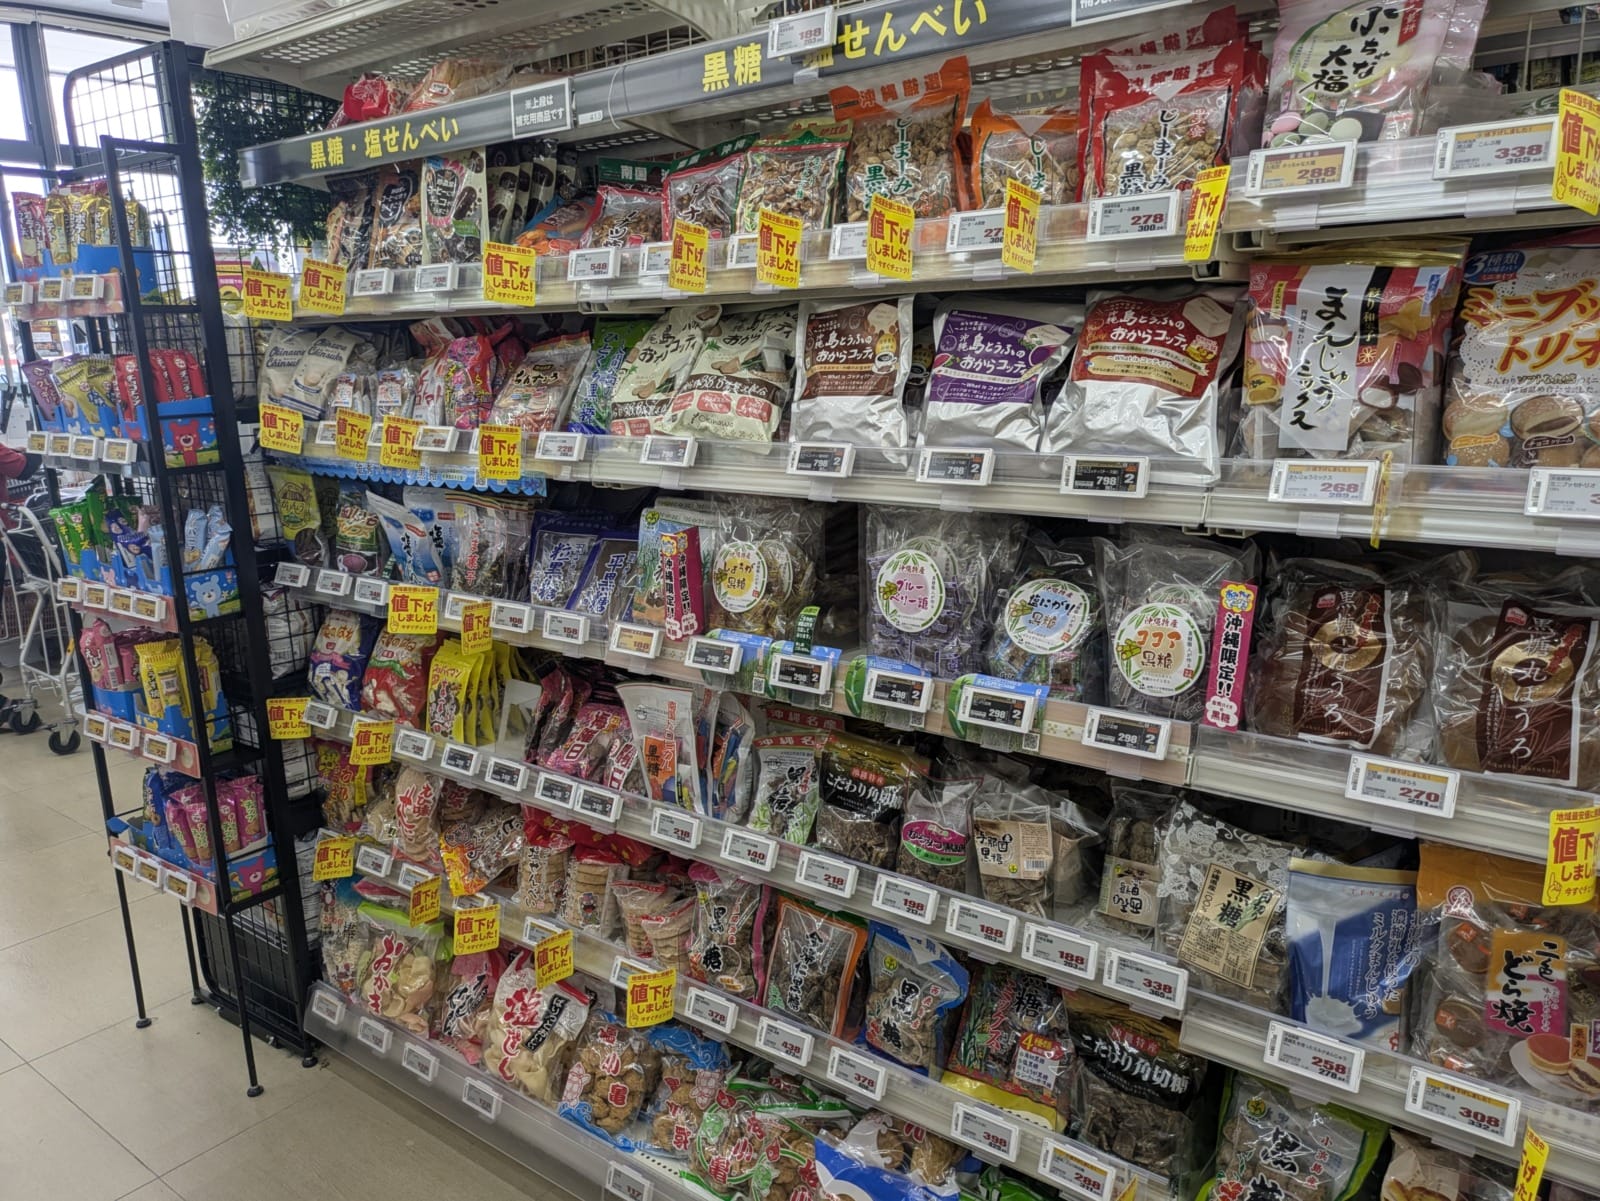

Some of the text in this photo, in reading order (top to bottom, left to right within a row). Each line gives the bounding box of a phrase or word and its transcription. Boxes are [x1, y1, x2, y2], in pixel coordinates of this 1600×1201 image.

[799, 27, 822, 40] 188
[1299, 44, 1352, 94] 大福
[310, 117, 459, 170] 黒糖・塩せんべい
[1150, 109, 1174, 191] じーまーみ
[1494, 144, 1543, 158] 338
[894, 115, 913, 194] じーまーみ
[1297, 166, 1337, 180] 288
[1567, 157, 1600, 192] しました
[1007, 195, 1036, 236] 値下げ
[1131, 213, 1164, 226] 278
[870, 210, 911, 245] 値下げ
[760, 224, 798, 256] 値下げ
[673, 238, 704, 263] 値下げ
[486, 254, 533, 279] 値下げ
[1110, 326, 1189, 350] おからコッティ
[816, 348, 874, 364] おからコッティ
[1311, 285, 1360, 413] まんじゅう
[960, 354, 1027, 374] おからコッティ
[1288, 361, 1318, 430] ミックス
[385, 423, 417, 447] 値下
[480, 434, 517, 456] 値下げ
[814, 459, 828, 468] 798
[833, 458, 841, 467] 2
[947, 465, 965, 475] 798
[970, 464, 979, 474] 2
[1096, 475, 1117, 486] 798
[1124, 473, 1135, 484] 2
[1320, 482, 1359, 494] 268
[896, 578, 925, 592] ブルー
[391, 594, 435, 613] 値下げ
[1029, 610, 1058, 630] 黒糖
[1136, 629, 1182, 649] ココア
[723, 654, 729, 663] 2
[1142, 650, 1174, 670] 黒糖
[1217, 613, 1243, 697] 沖縄限定!!
[793, 673, 807, 682] 298
[811, 673, 819, 682] 2
[891, 690, 906, 700] 298
[912, 690, 920, 700] 2
[988, 709, 1006, 721] 298
[1012, 708, 1021, 720] 2
[758, 735, 816, 746] 沖縄名
[1118, 732, 1138, 745] 298
[1145, 733, 1155, 745] 2
[1398, 787, 1440, 803] 270
[673, 827, 690, 838] 218
[746, 849, 765, 861] 140
[823, 873, 844, 886] 218
[1561, 863, 1594, 882] しまし
[903, 897, 924, 911] 198
[1218, 876, 1254, 930] 黒糖
[979, 923, 1004, 938] 188
[1058, 950, 1084, 965] 188
[1142, 977, 1173, 994] 338
[1492, 949, 1537, 1034] どら焼
[630, 984, 672, 1005] 値下げ
[708, 1009, 726, 1022] 378
[781, 1041, 801, 1054] 438
[1080, 1034, 1190, 1095] こだわり角切糖
[1311, 1055, 1346, 1074] 258
[854, 1073, 875, 1088] 378
[1459, 1106, 1499, 1127] 308
[984, 1131, 1007, 1147] 398
[1074, 1173, 1101, 1190] 288
